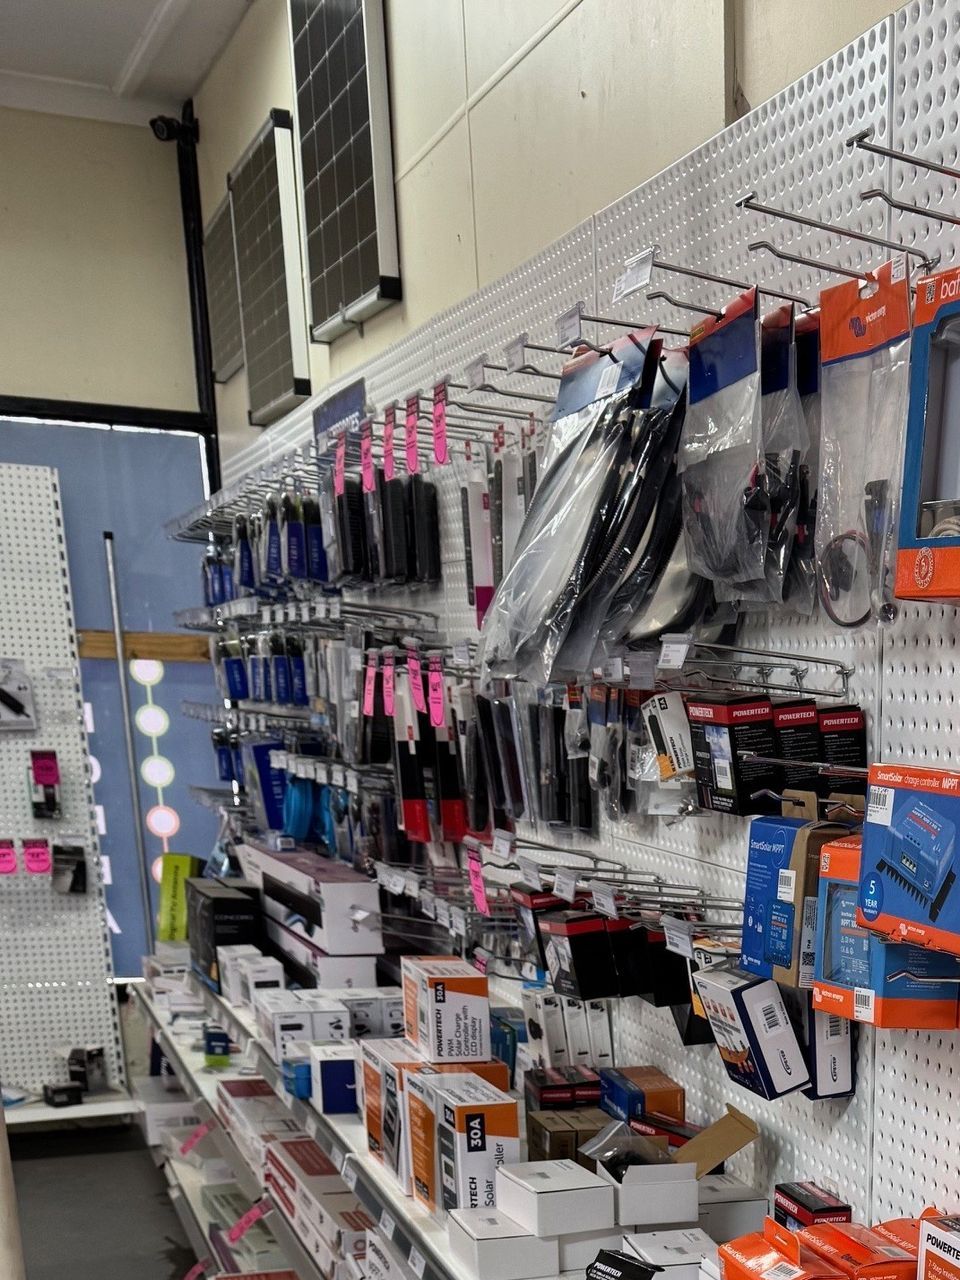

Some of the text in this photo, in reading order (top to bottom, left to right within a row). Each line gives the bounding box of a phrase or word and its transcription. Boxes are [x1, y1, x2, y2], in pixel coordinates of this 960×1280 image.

[689, 707, 713, 718] POWERTECH
[733, 707, 769, 717] POWERTECH
[779, 711, 815, 721] POWERTECH
[823, 717, 859, 725] POWERTECH
[877, 771, 902, 782] SmartSolar
[904, 775, 919, 785] charge
[920, 778, 940, 787] controller
[942, 779, 958, 791] MPPT
[750, 839, 772, 852] SmartSolar
[869, 880, 876, 894] 5
[864, 898, 877, 909] YEAR
[436, 1009, 444, 1057] POWERTECH
[470, 1116, 482, 1147] 30A
[484, 1179, 495, 1208] Solar
[775, 1192, 798, 1214] POWERTECH
[594, 1262, 622, 1277] POWERTECH
[928, 1260, 942, 1275] 7-Step
